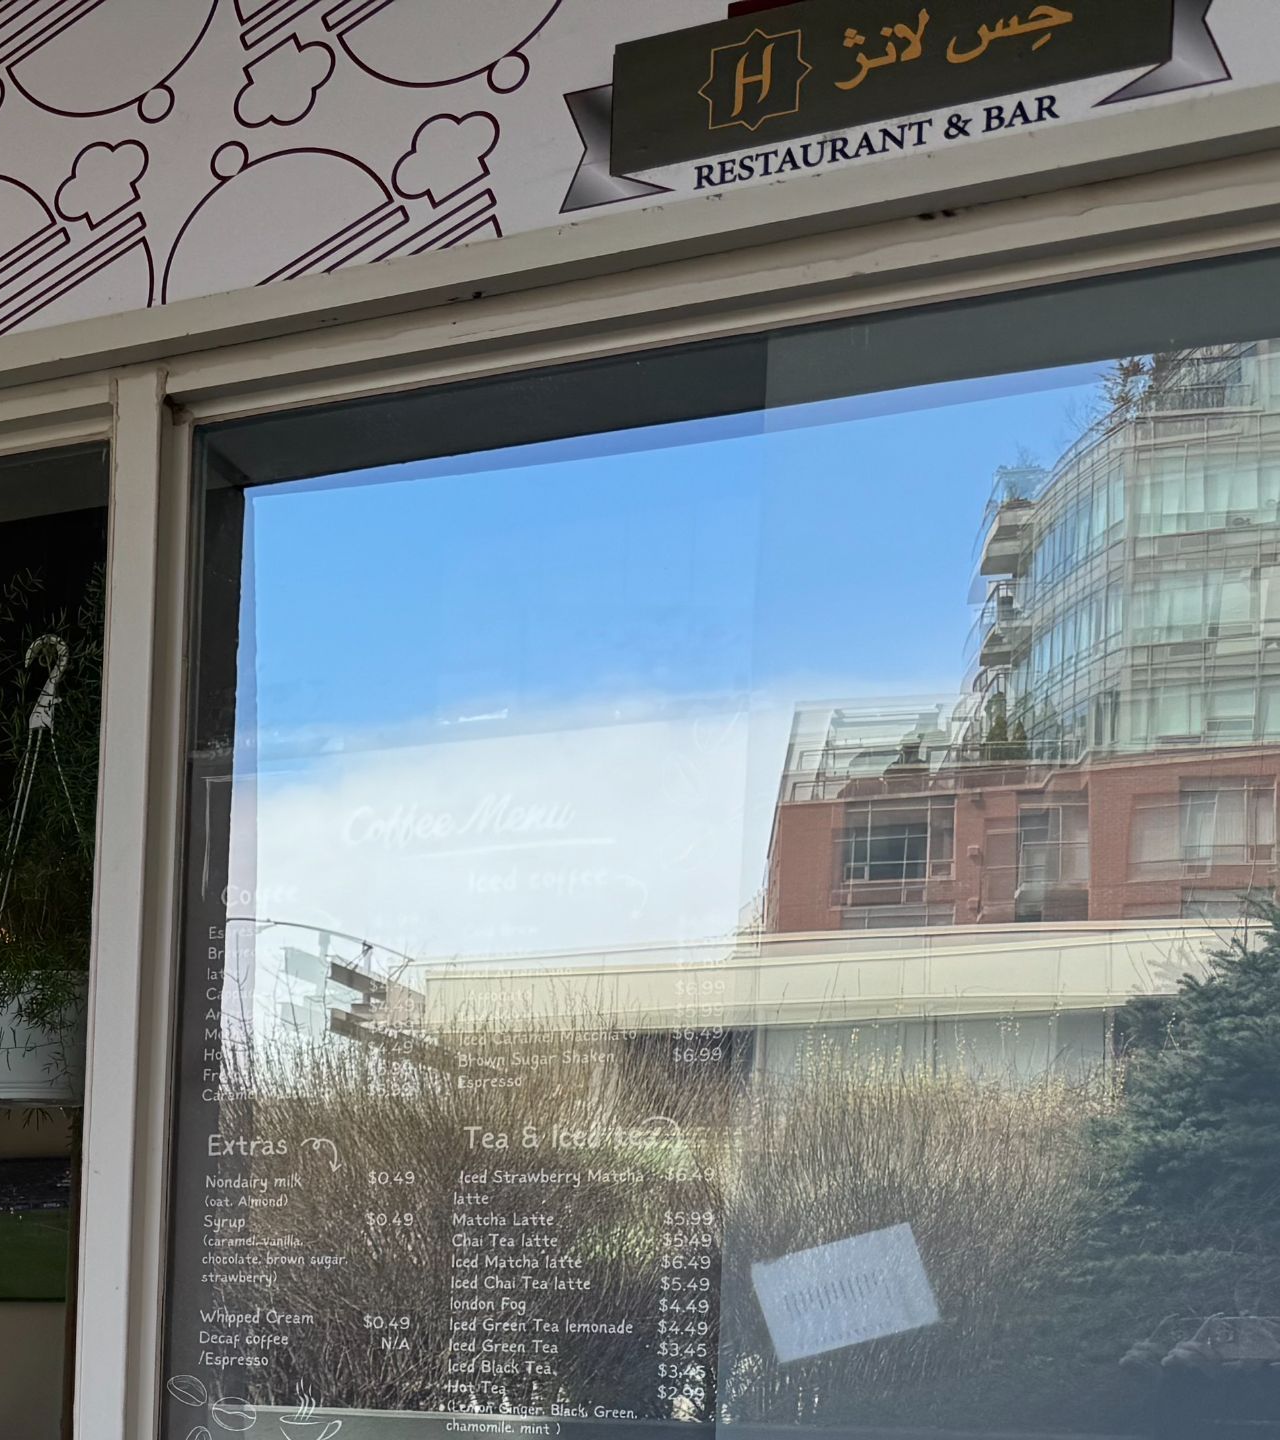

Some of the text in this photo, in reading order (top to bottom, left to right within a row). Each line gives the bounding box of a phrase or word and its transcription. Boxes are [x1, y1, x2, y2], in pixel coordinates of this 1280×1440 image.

[693, 95, 1060, 190] RESTAURANT & BAR
[341, 792, 576, 848] Coffee Menu
[467, 862, 609, 897] Iced coffee
[674, 980, 725, 996] $6.99
[672, 1026, 723, 1041] $6.49
[458, 1046, 722, 1070] Brown Sugar Shaken $6.99
[457, 1074, 523, 1090] Espresso
[464, 1126, 509, 1149] Tea
[522, 1126, 539, 1148] &
[552, 1123, 601, 1148] Iced
[208, 1133, 288, 1157] Extras
[205, 1170, 415, 1192] Nondairy milk $0.49
[459, 1169, 487, 1184] Iced
[493, 1169, 581, 1188] Strawberry
[587, 1168, 644, 1183] Matcha
[238, 1194, 288, 1208] Almond)
[453, 1192, 489, 1206] latte
[204, 1211, 414, 1233] Syrup $0.49
[452, 1210, 714, 1227] Matcha Latte $5.99
[451, 1232, 713, 1248] Chai Tea latte $5.49
[266, 1253, 305, 1265] brown
[451, 1253, 711, 1270] Iced Matcha latte $6.49
[201, 1271, 277, 1288] strawberry)
[451, 1275, 710, 1292] Iced Chai Tea latte $5.49
[501, 1298, 526, 1315] Fog
[659, 1298, 710, 1315] $4.49
[200, 1309, 411, 1330] Whipped Cream $0.49
[450, 1318, 709, 1336] Iced Green Tea lemonade $4.49
[199, 1330, 410, 1350] Decaf coffee N/A
[449, 1339, 707, 1358] Iced Green Tea $3.45
[448, 1360, 706, 1379] Iced Black Tea $3.45
[447, 1381, 475, 1394] Hot
[481, 1381, 506, 1395] Tea
[521, 1423, 550, 1435] mint
